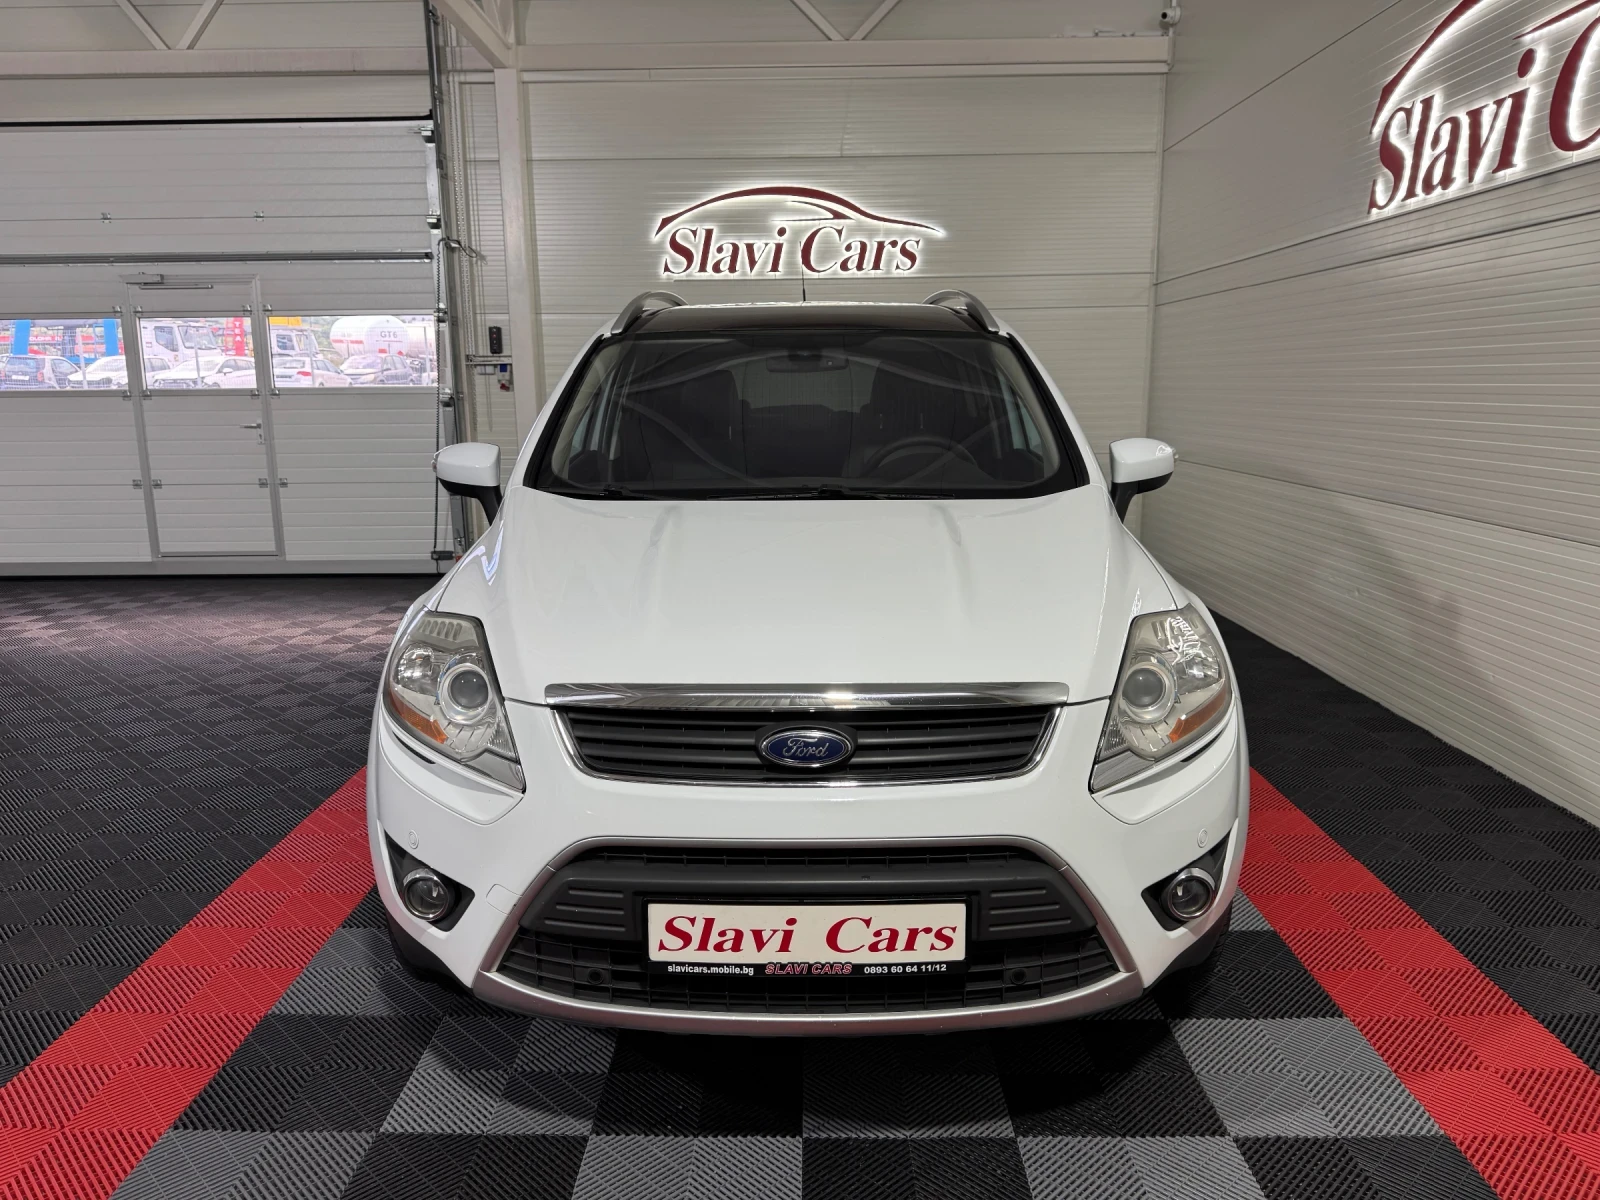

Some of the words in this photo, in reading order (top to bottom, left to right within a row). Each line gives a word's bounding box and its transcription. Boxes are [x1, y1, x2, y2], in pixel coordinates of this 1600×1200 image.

[1367, 47, 1536, 215] Slavi
[662, 226, 787, 275] Slavi
[800, 225, 921, 273] Cars
[380, 330, 398, 339] GT6
[782, 737, 830, 757] Ford
[658, 916, 798, 953] Slavi
[825, 916, 958, 953] Cars
[667, 964, 755, 976] slavicars.mobile.bg
[765, 963, 809, 975] SLAVI
[811, 963, 853, 975] CARS
[864, 966, 888, 974] 0893
[890, 965, 903, 973] 60
[905, 965, 918, 973] 64
[920, 963, 947, 972] 11/12
